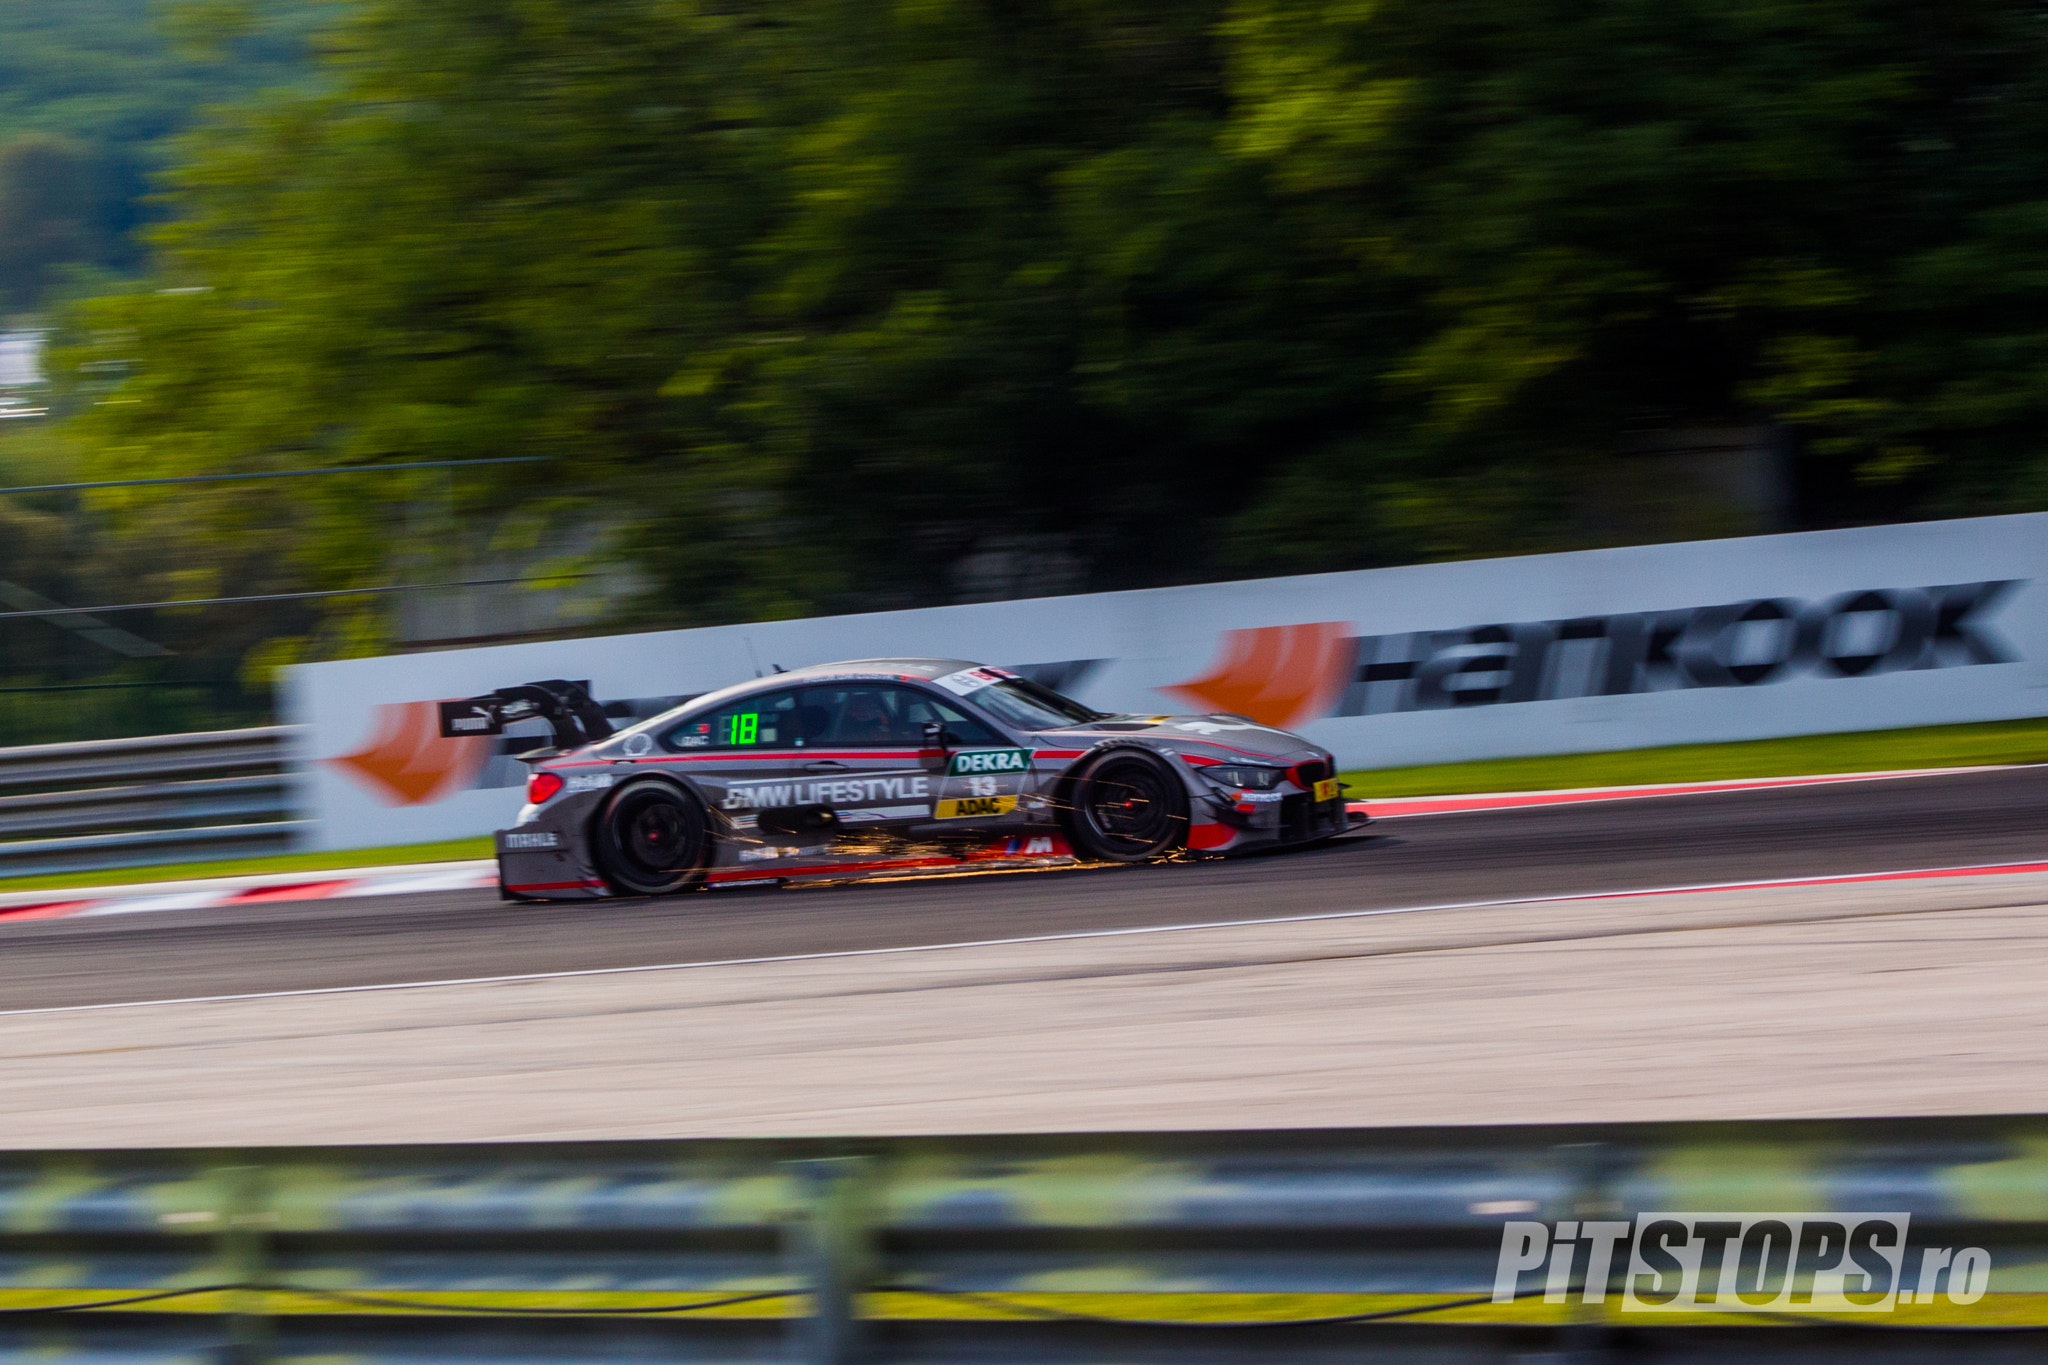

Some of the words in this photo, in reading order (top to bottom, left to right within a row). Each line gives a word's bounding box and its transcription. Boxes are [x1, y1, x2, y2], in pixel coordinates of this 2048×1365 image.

[730, 713, 758, 745] 18
[957, 752, 1024, 773] DEKRA
[723, 786, 792, 809] BMW
[794, 776, 930, 805] LIFESTYLE
[968, 776, 997, 797] 13
[956, 798, 1001, 816] ADAC
[505, 833, 558, 848] MAHLE
[1024, 837, 1053, 854] M
